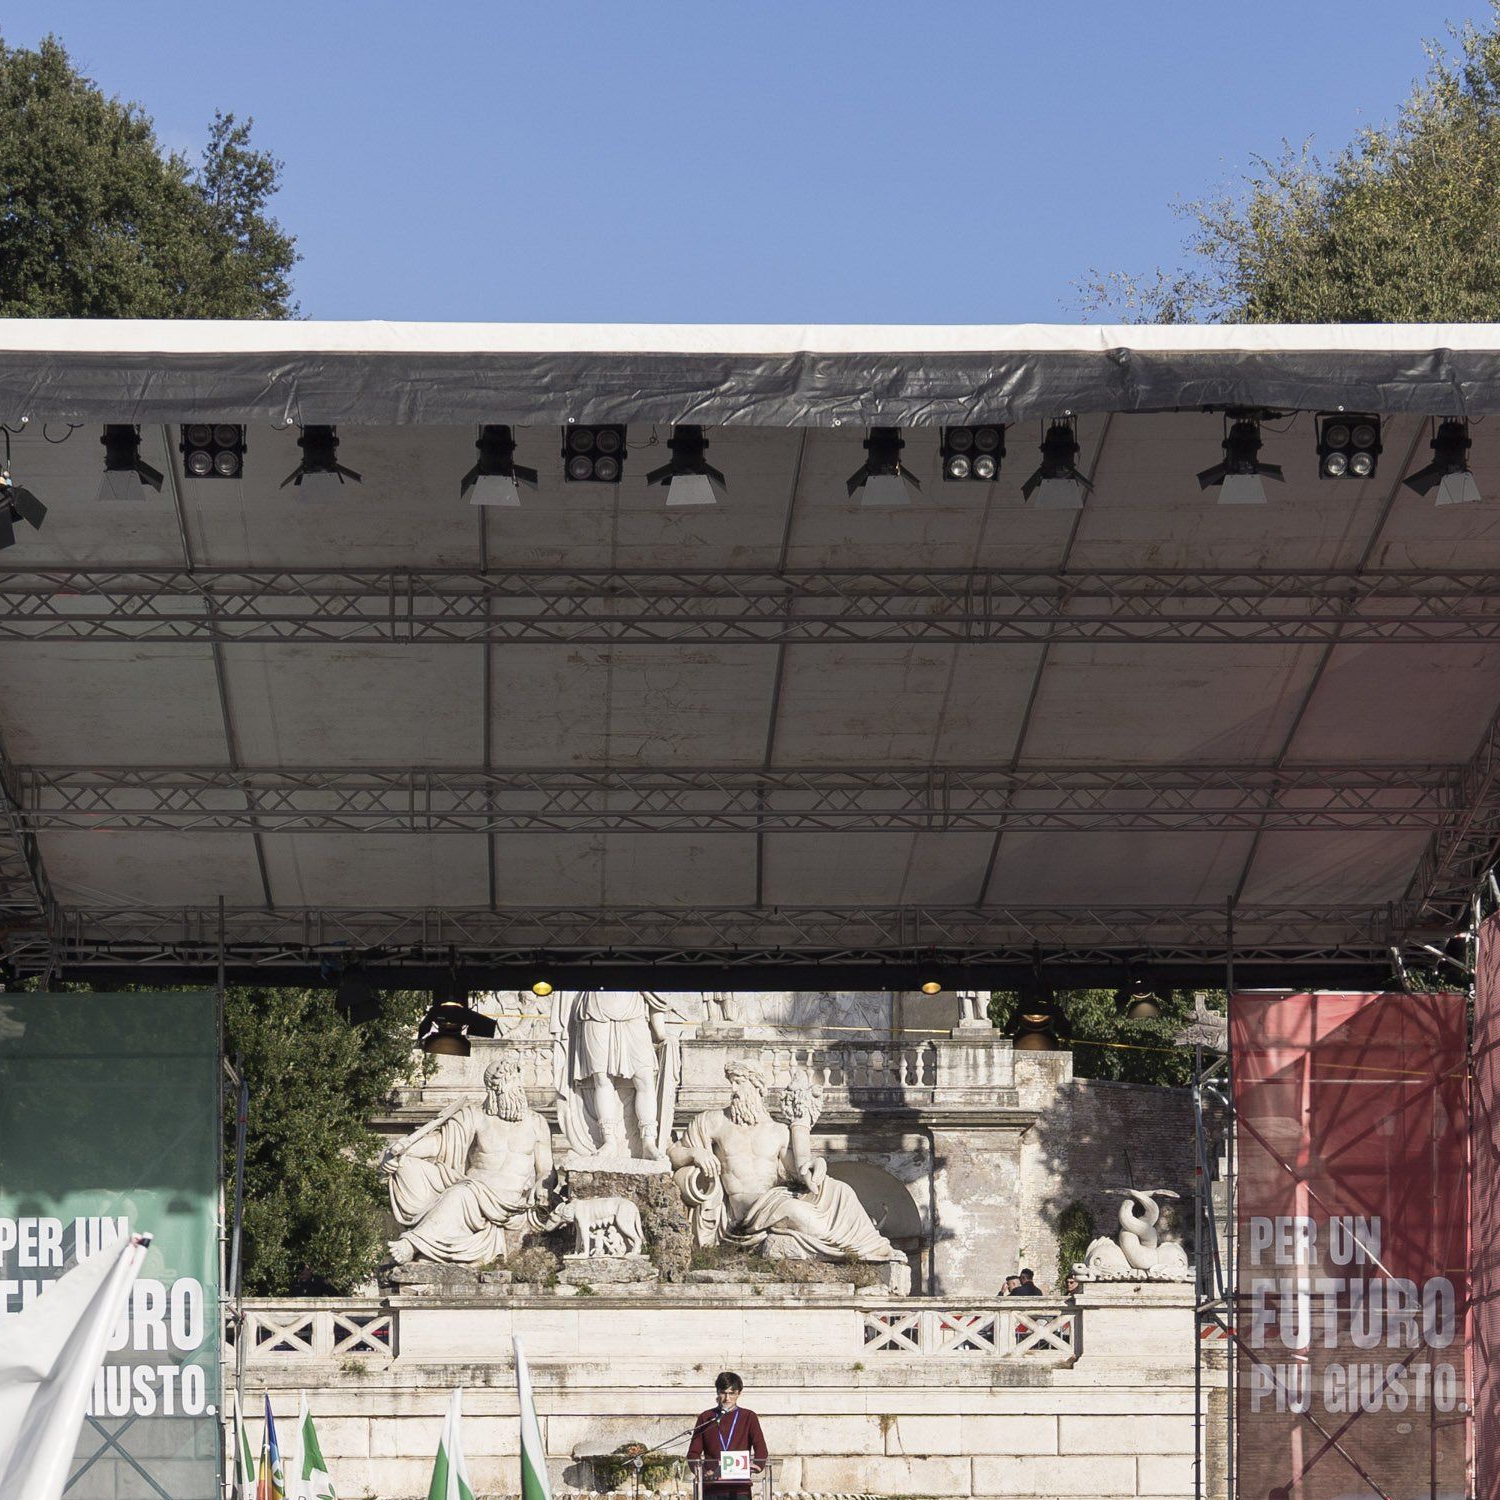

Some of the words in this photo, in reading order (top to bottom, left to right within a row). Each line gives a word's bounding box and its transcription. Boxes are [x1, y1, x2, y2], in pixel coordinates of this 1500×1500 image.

[1250, 1216, 1318, 1266] PER
[1329, 1216, 1382, 1266] UN
[1250, 1276, 1456, 1350] FUTURO
[1250, 1354, 1312, 1414] PIÙ
[1324, 1363, 1468, 1414] GIUSTO.
